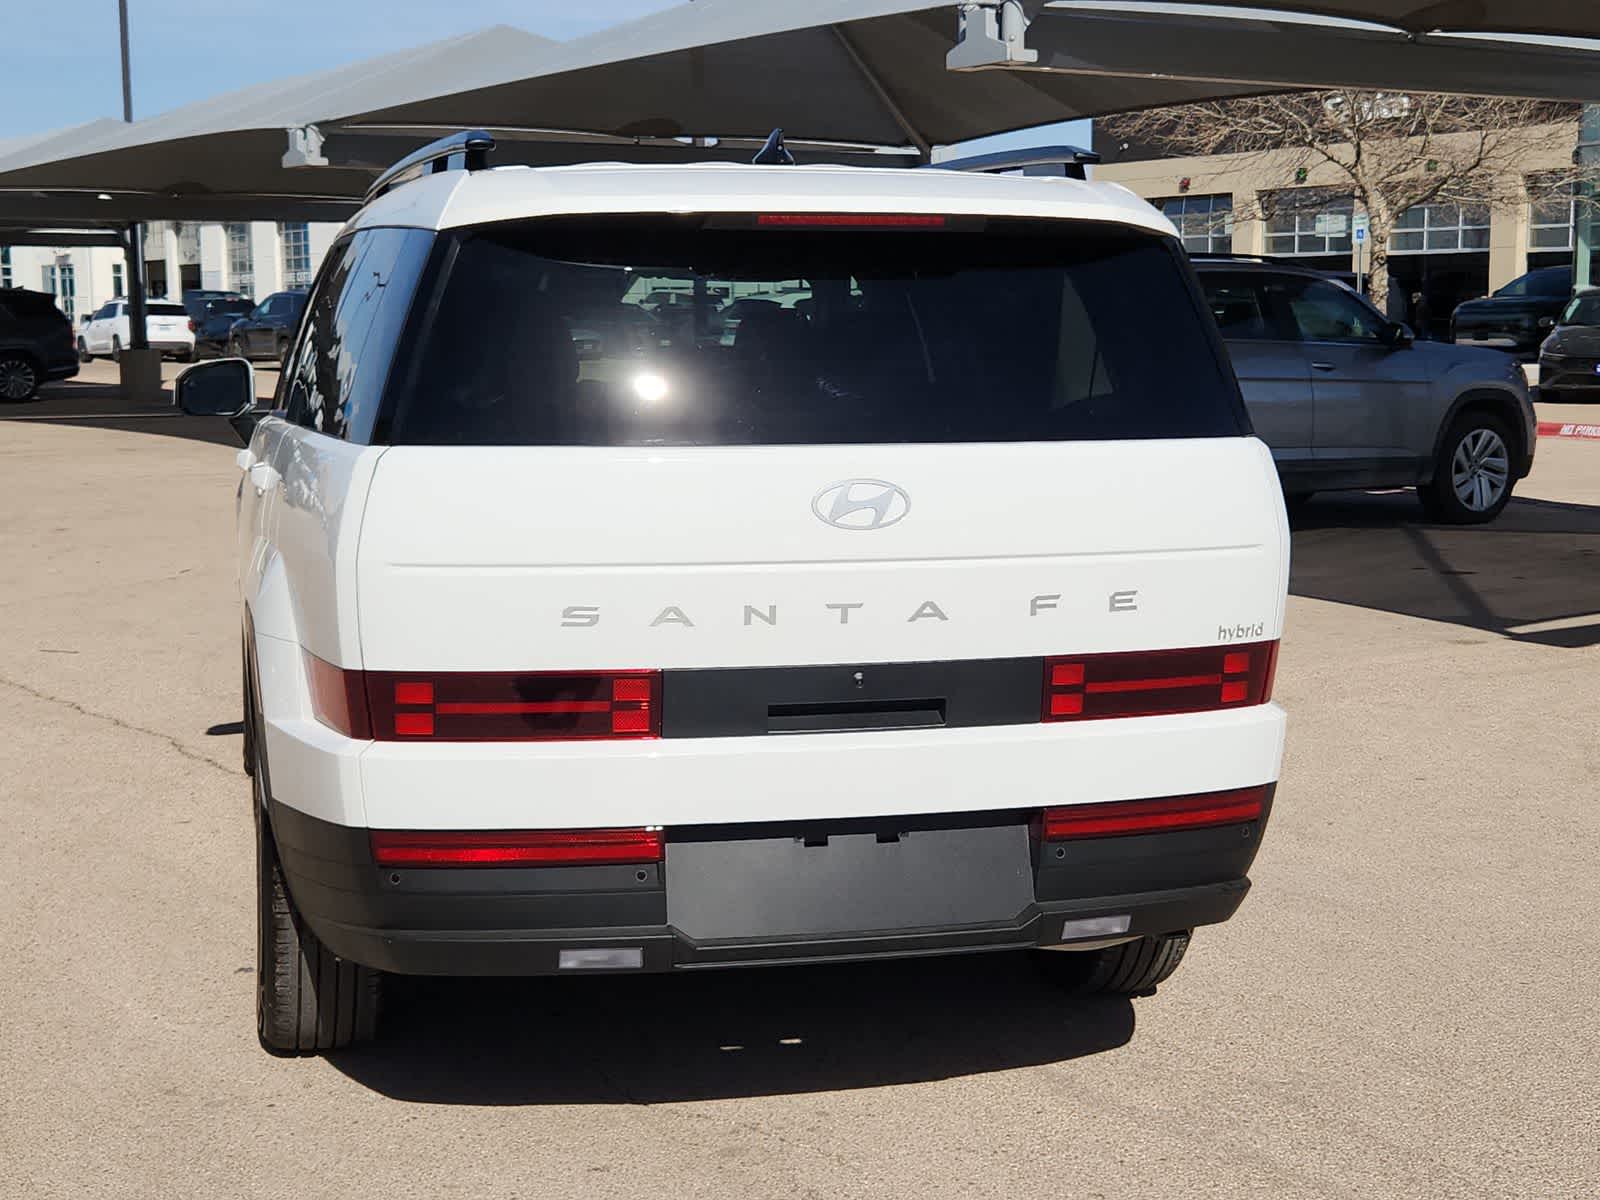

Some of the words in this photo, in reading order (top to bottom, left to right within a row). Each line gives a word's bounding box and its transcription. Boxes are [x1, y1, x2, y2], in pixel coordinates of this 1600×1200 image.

[560, 600, 949, 627] SANTA
[1029, 589, 1138, 617] FE
[1217, 621, 1264, 642] hybrid
